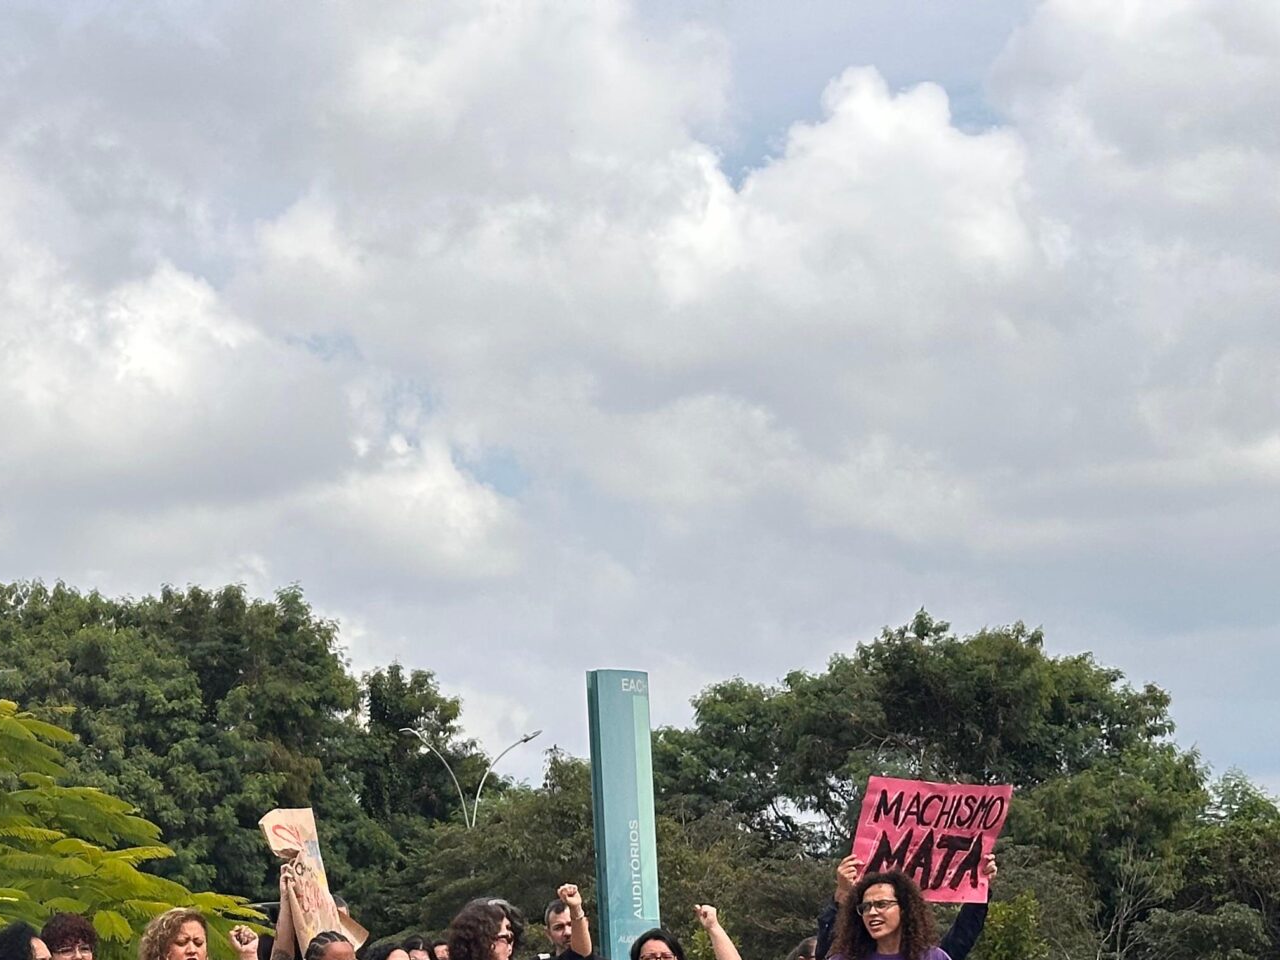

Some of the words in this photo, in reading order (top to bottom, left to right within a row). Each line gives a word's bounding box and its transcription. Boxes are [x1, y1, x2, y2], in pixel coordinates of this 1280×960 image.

[873, 789, 1005, 830] MACHISMO
[628, 819, 644, 920] AUDITÓRIOS
[864, 828, 983, 890] MATA
